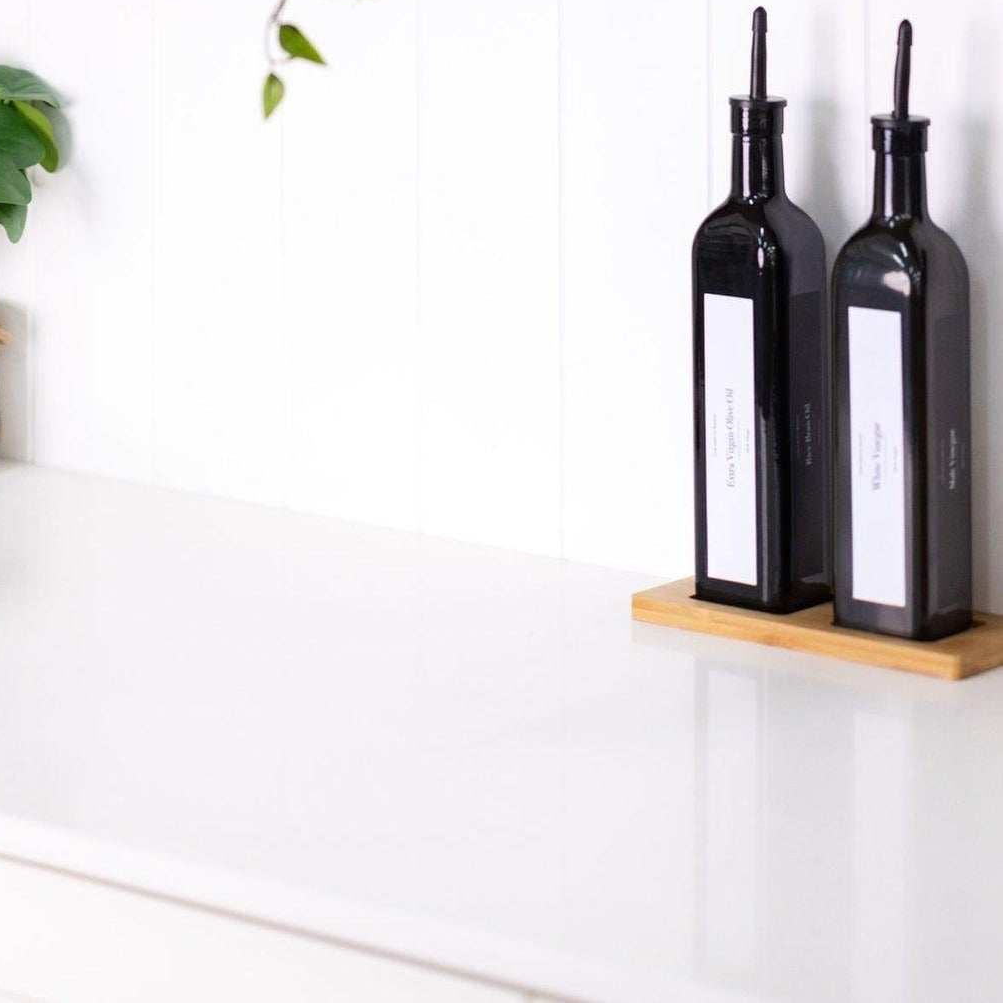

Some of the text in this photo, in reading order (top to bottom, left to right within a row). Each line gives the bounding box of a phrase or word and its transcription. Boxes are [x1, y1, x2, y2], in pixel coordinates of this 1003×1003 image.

[725, 388, 736, 487] Extra Virgin Olive Oil
